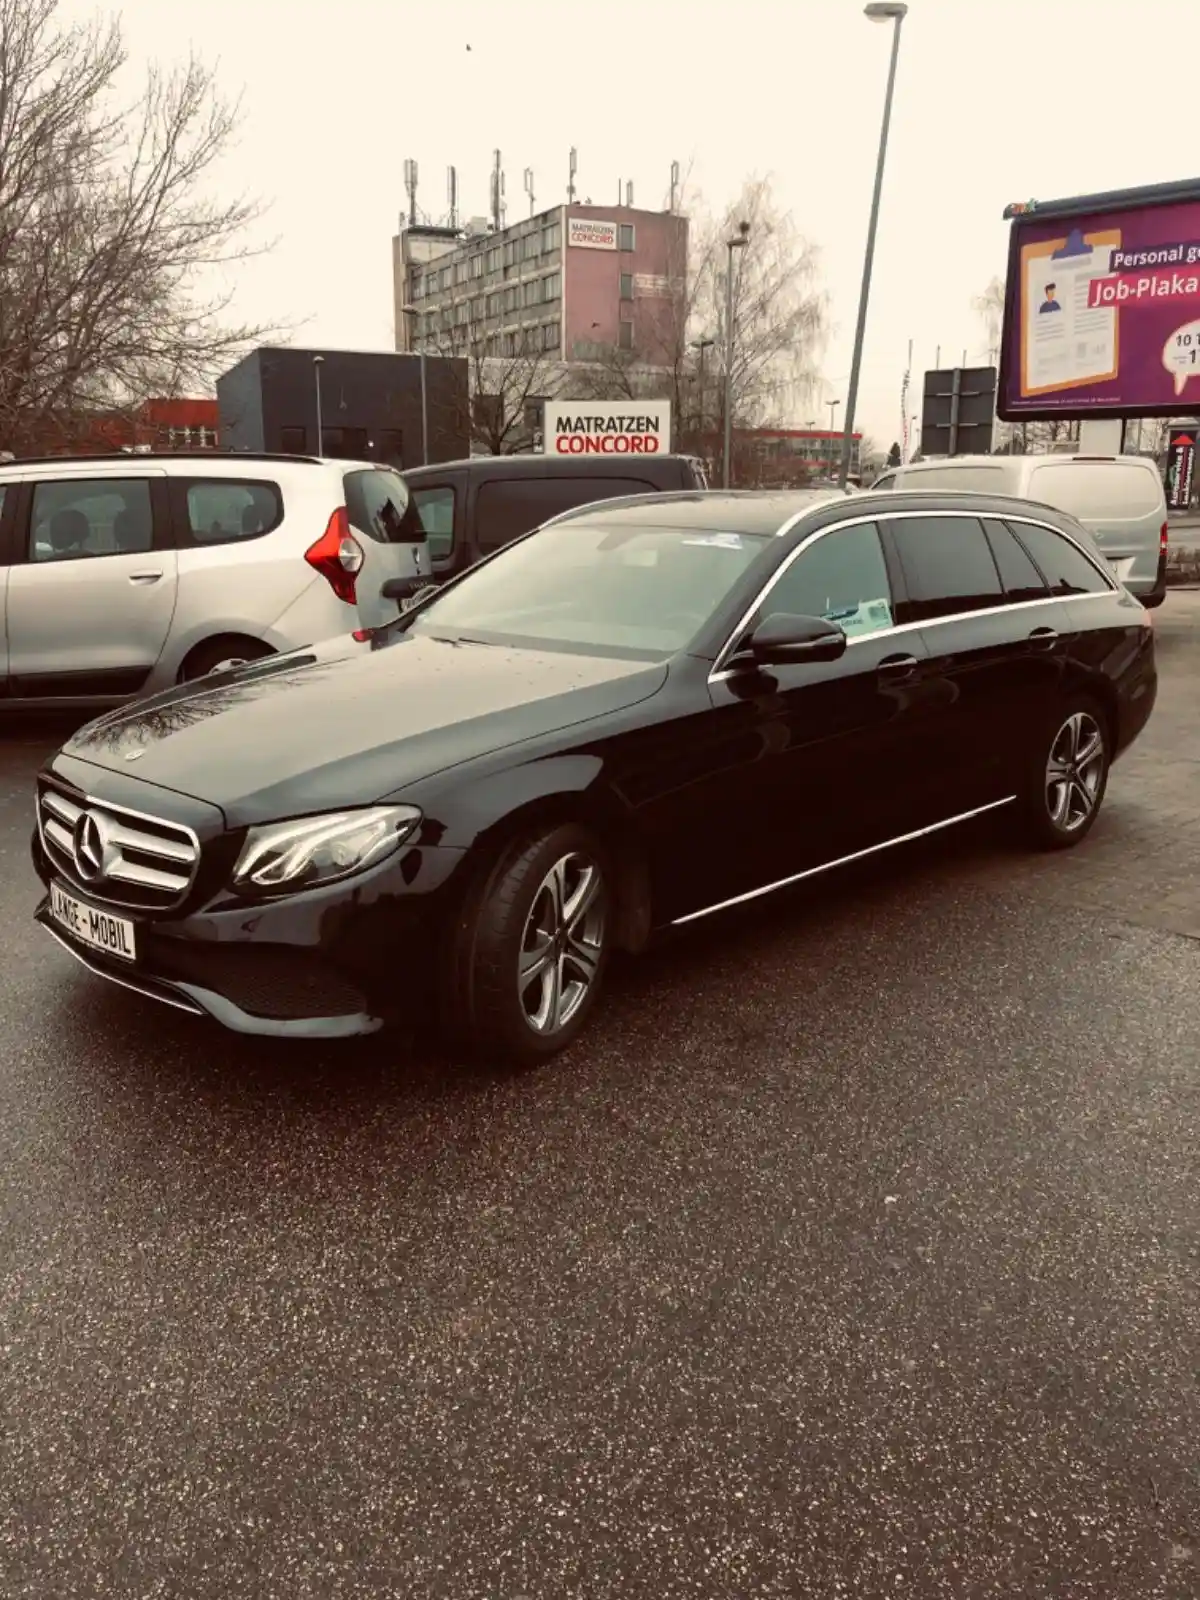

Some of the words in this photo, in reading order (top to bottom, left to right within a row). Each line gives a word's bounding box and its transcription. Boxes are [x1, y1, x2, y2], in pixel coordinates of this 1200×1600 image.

[571, 232, 614, 244] CONCORD
[1113, 245, 1184, 268] Personal
[1092, 273, 1198, 307] Job-Plaka
[1176, 334, 1191, 347] 10
[556, 416, 659, 433] MATRATZEN
[556, 435, 659, 454] CONCORD
